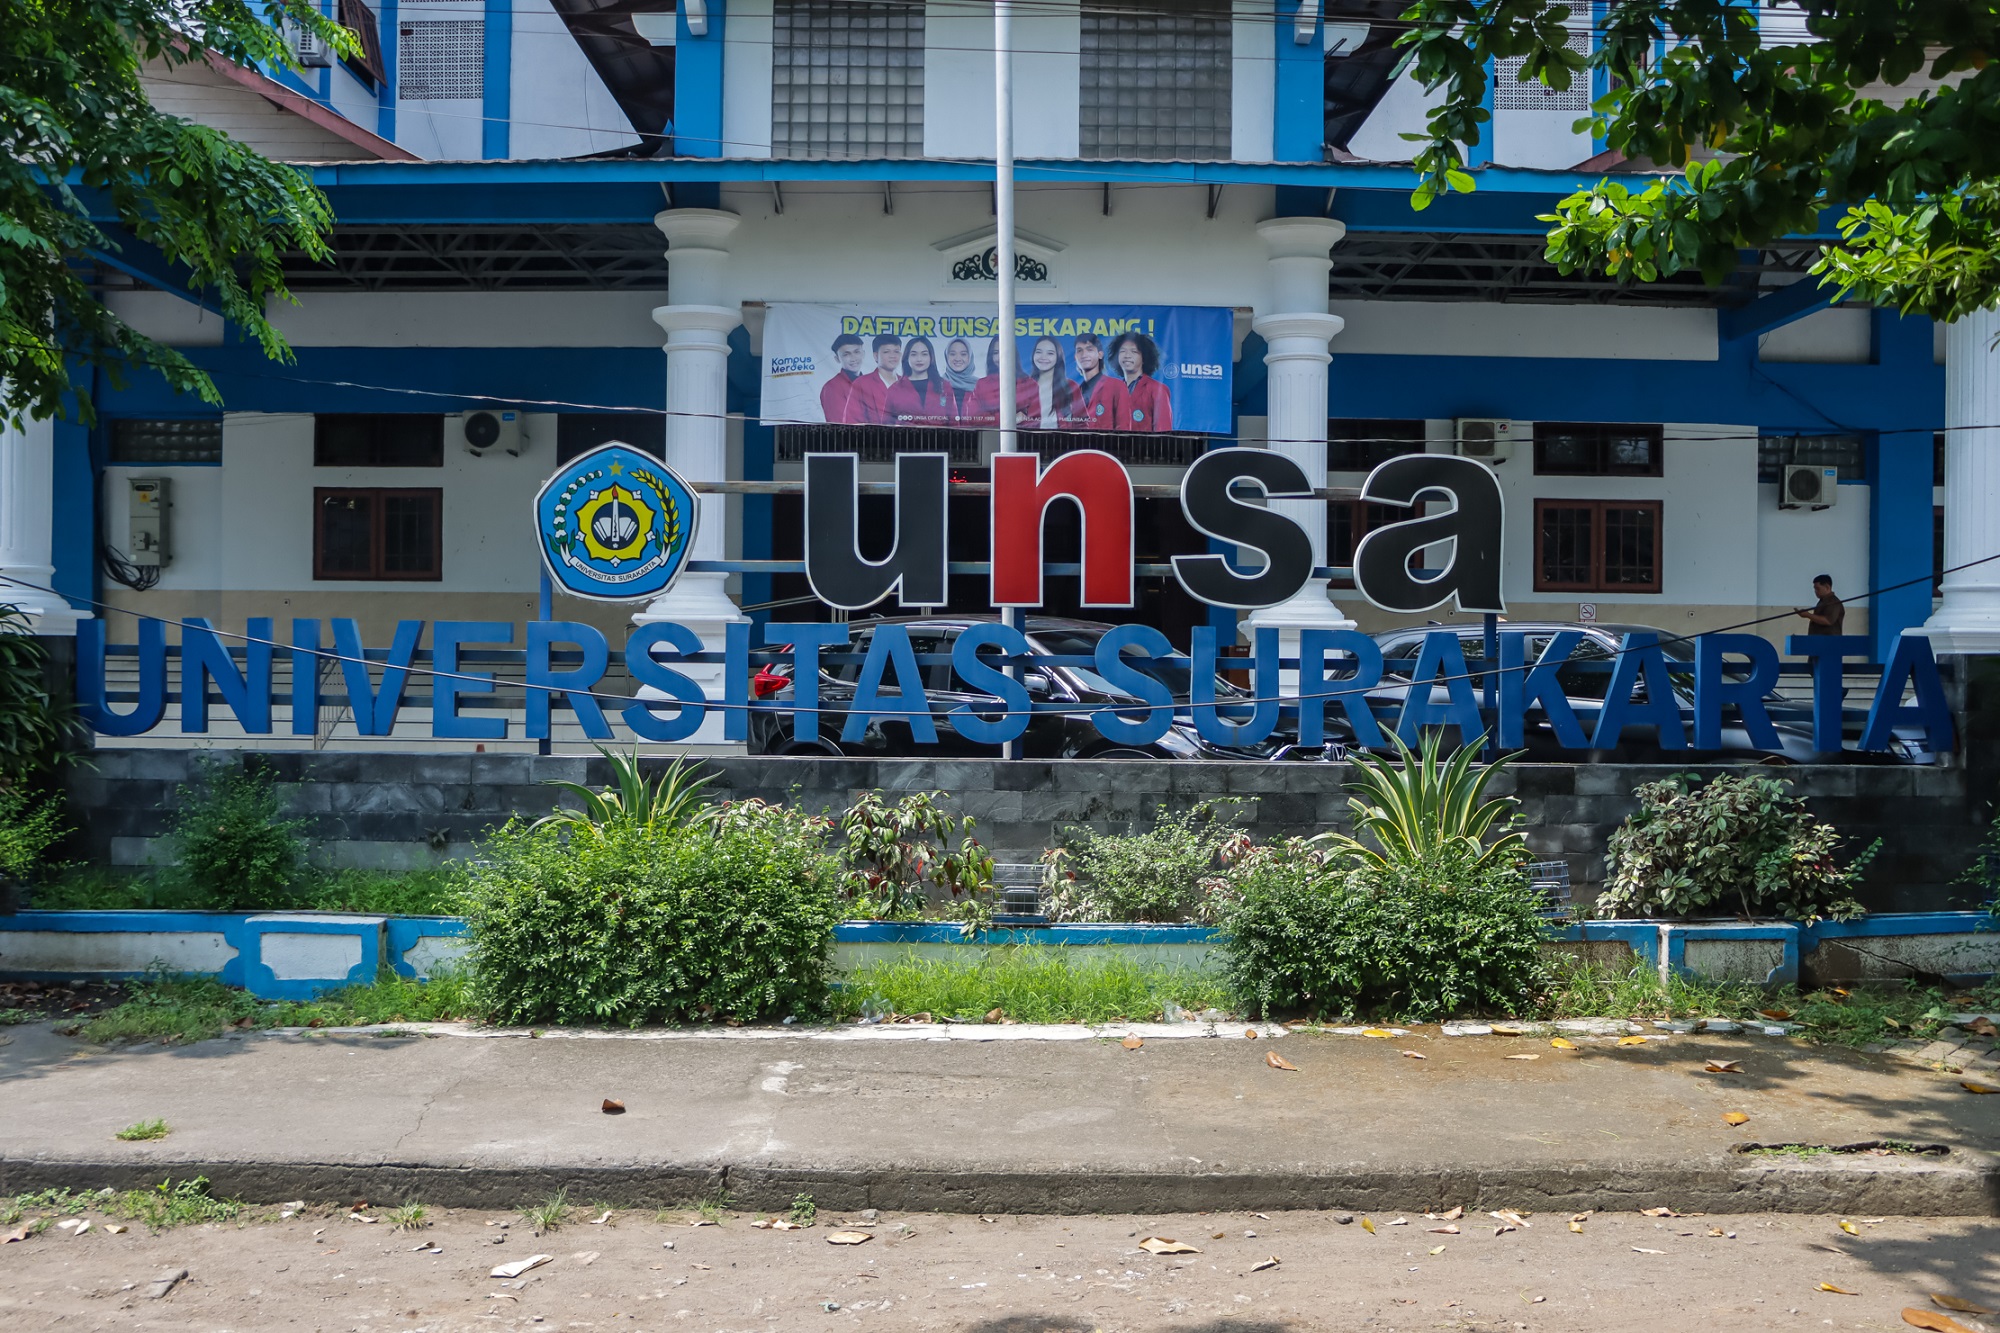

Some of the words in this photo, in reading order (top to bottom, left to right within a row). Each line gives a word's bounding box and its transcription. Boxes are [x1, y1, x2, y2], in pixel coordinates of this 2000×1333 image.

[841, 316, 936, 337] DAFTAR
[940, 317, 999, 337] UNSA
[1015, 318, 1141, 337] SEKARANG
[771, 356, 812, 367] Kampus
[771, 363, 815, 374] Merdeka
[1181, 363, 1223, 376] unsa
[803, 446, 1507, 614] unsa
[575, 561, 616, 582] UNIVERSITAS
[618, 561, 657, 582] SURAKARTA
[76, 617, 1032, 746] UNIVERSITAS
[1089, 624, 1955, 753] SURAKARTA
